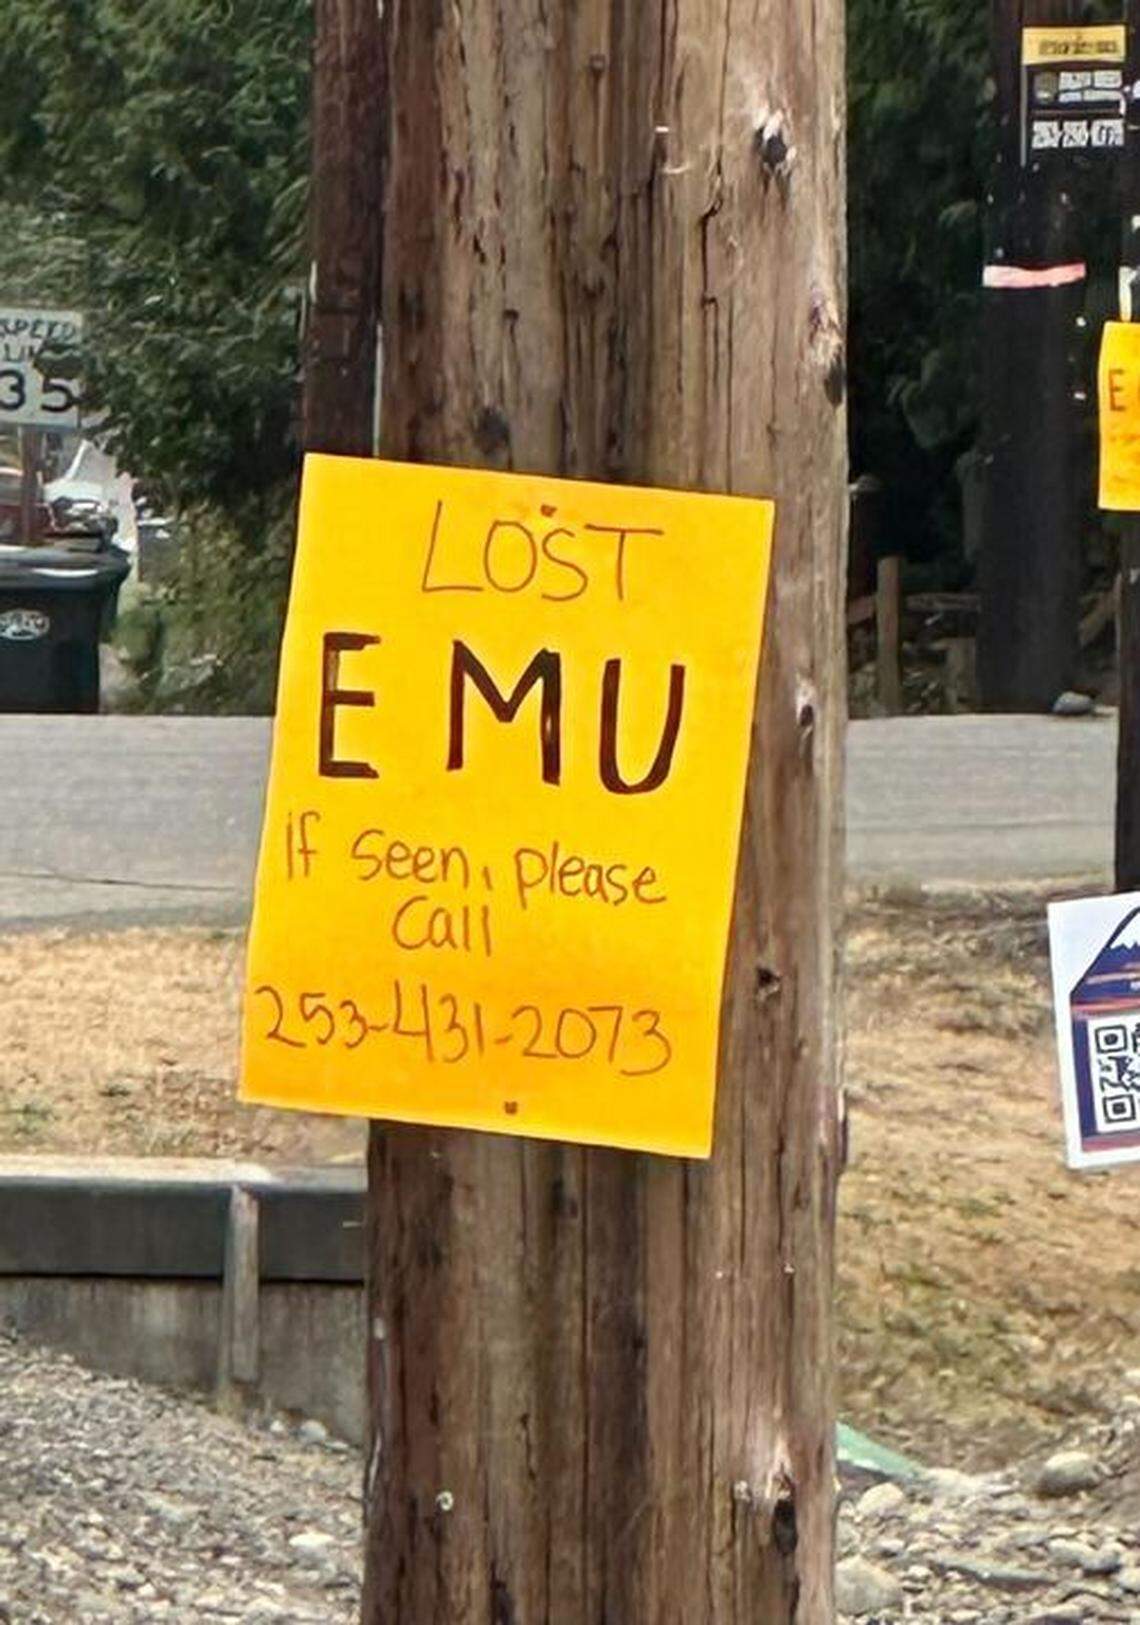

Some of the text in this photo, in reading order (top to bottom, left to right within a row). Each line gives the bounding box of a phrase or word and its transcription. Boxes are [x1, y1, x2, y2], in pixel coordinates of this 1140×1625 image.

[0, 369, 74, 413] 35
[1109, 369, 1126, 411] E
[422, 500, 663, 601] LOST
[318, 631, 686, 795] EMU
[514, 841, 667, 909] please
[256, 980, 671, 1076] 253-431-2073
